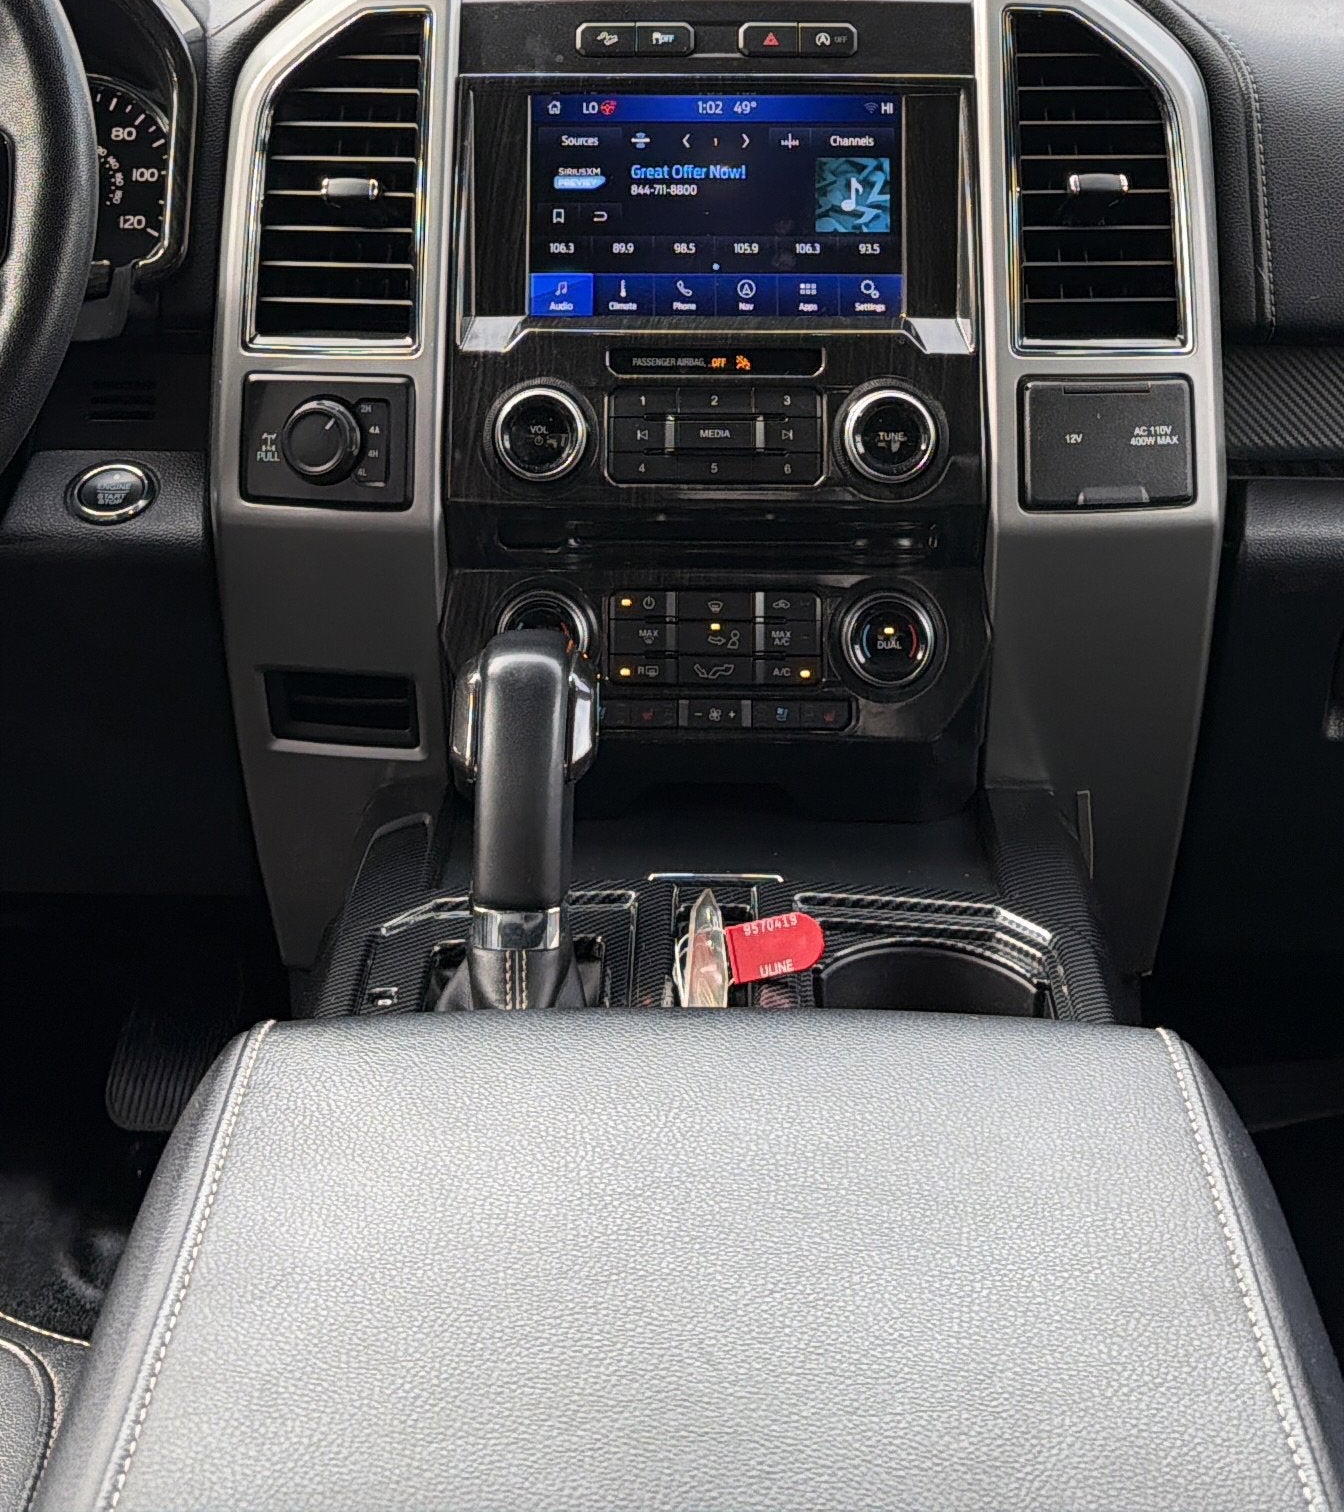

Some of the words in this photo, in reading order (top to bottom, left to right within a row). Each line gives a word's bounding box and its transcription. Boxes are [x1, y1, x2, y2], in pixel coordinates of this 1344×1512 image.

[582, 101, 599, 115] LO
[697, 100, 724, 115] 1:02
[880, 102, 895, 115] HI
[111, 127, 137, 141] 80
[561, 135, 599, 147] Sources
[829, 135, 875, 147] Channels
[131, 168, 159, 182] 100
[630, 164, 669, 179] Great
[671, 164, 707, 179] Offer
[709, 164, 747, 179] Now!
[630, 184, 698, 196] 844-711-8800
[119, 214, 146, 229] 120
[549, 242, 575, 255] 106.3
[612, 242, 635, 255] 89.9
[672, 242, 697, 255] 98.5
[733, 242, 760, 255] 105.9
[795, 242, 821, 255] 106.3
[858, 242, 881, 255] 93.5
[549, 300, 574, 311] Audio
[608, 300, 638, 311] Climate
[672, 300, 697, 311] Phone
[738, 300, 755, 311] Nav
[798, 300, 819, 313] Apps
[854, 300, 886, 313] Settings
[632, 357, 676, 367] PASSENGER
[711, 357, 727, 368] OFF
[640, 395, 647, 406] 1
[710, 395, 719, 406] 2
[783, 395, 792, 407] 3
[360, 403, 373, 414] 2H
[368, 425, 381, 434] 4A
[530, 425, 550, 434] VOL
[699, 429, 731, 438] MEDIA
[1134, 426, 1149, 436] AC
[1151, 425, 1173, 435] 110V
[877, 431, 905, 441] TUNE
[1064, 433, 1083, 444] 12V
[1130, 436, 1156, 446] 400W
[1157, 435, 1180, 445] MAX
[256, 451, 281, 461] PULL
[367, 448, 379, 458] 4H
[638, 463, 646, 473] 4
[710, 463, 719, 474] 5
[783, 464, 792, 474] 6
[96, 481, 132, 491] ENGINE
[638, 629, 660, 638] MAX
[771, 630, 792, 639] MAX
[773, 638, 791, 646] A/C
[877, 640, 903, 650] DUAL
[772, 667, 792, 677] A/C
[742, 914, 798, 937] 9570419
[759, 958, 795, 978] ULINE
